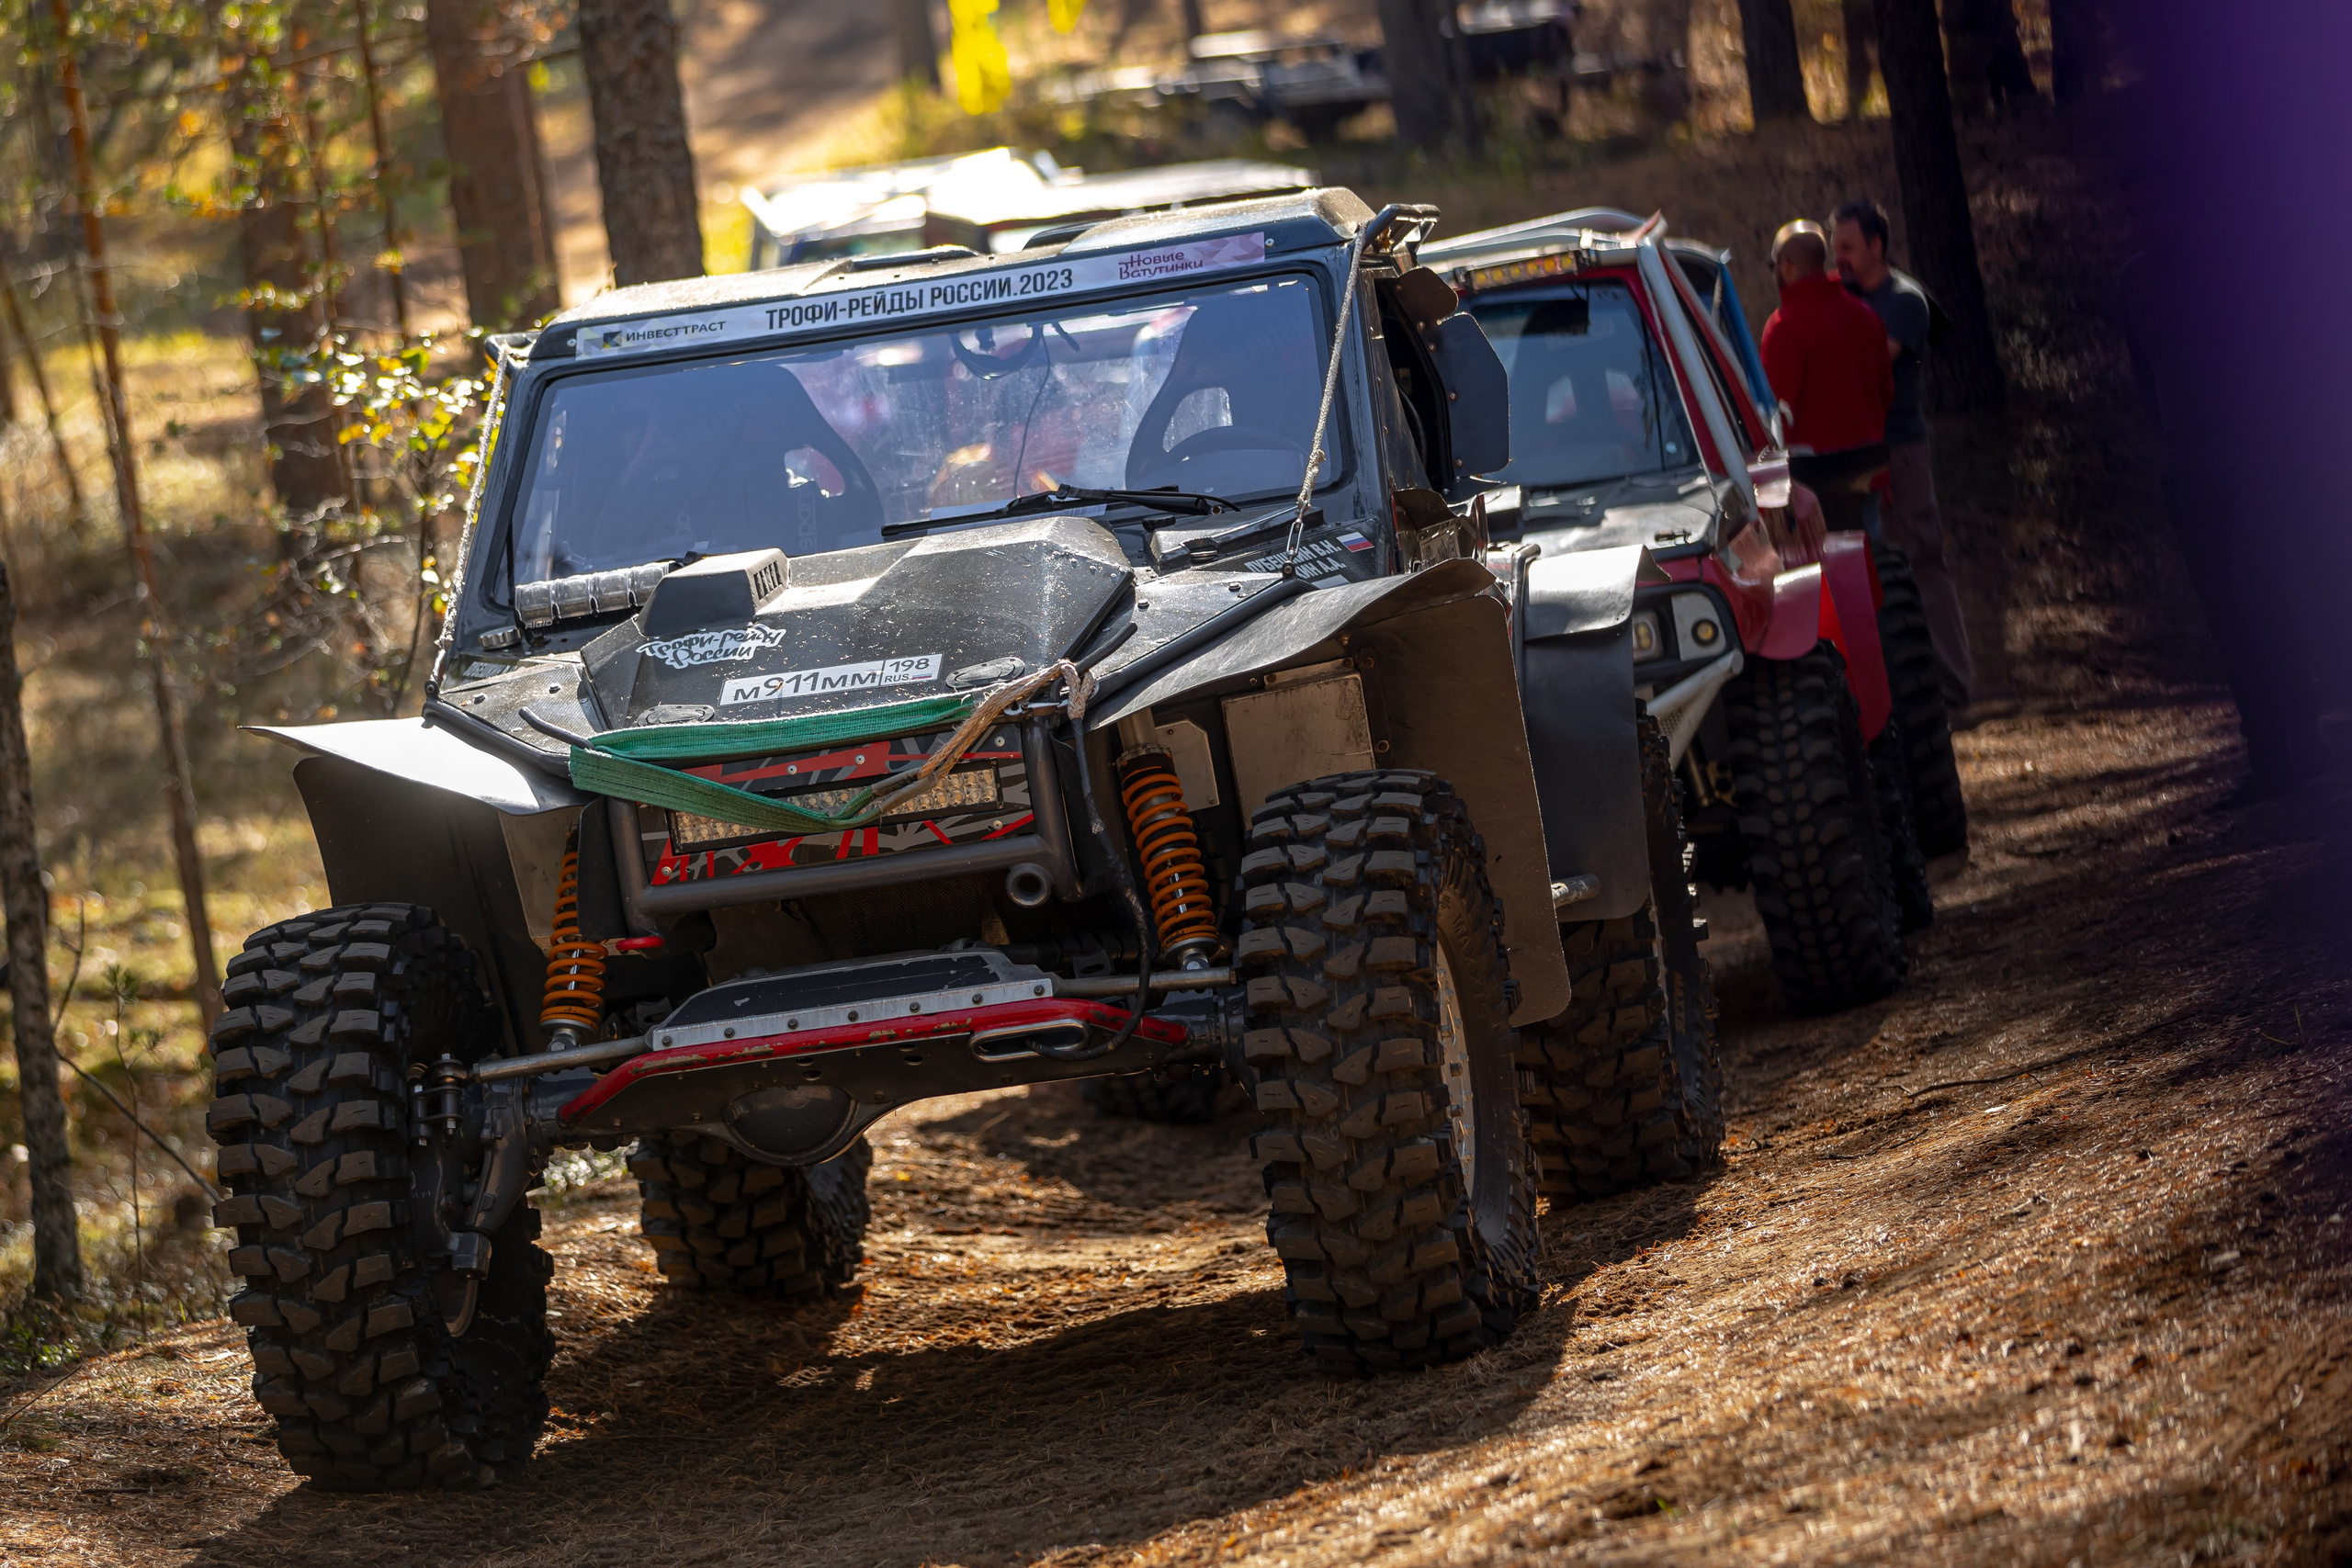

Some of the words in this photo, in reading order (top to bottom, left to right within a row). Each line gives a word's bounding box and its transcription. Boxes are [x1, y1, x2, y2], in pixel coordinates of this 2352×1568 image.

[1118, 252, 1184, 267] Новые
[1119, 260, 1203, 280] Ватутинки
[766, 289, 923, 330] ТРОФИ-РЕЙДЫ
[930, 268, 1073, 307] РОССИИ.2023
[626, 321, 726, 343] ИНВЕСТТРАСТ
[525, 620, 552, 629] RIGID
[670, 646, 752, 667] России
[888, 658, 930, 672] 198
[884, 673, 910, 682] RUS
